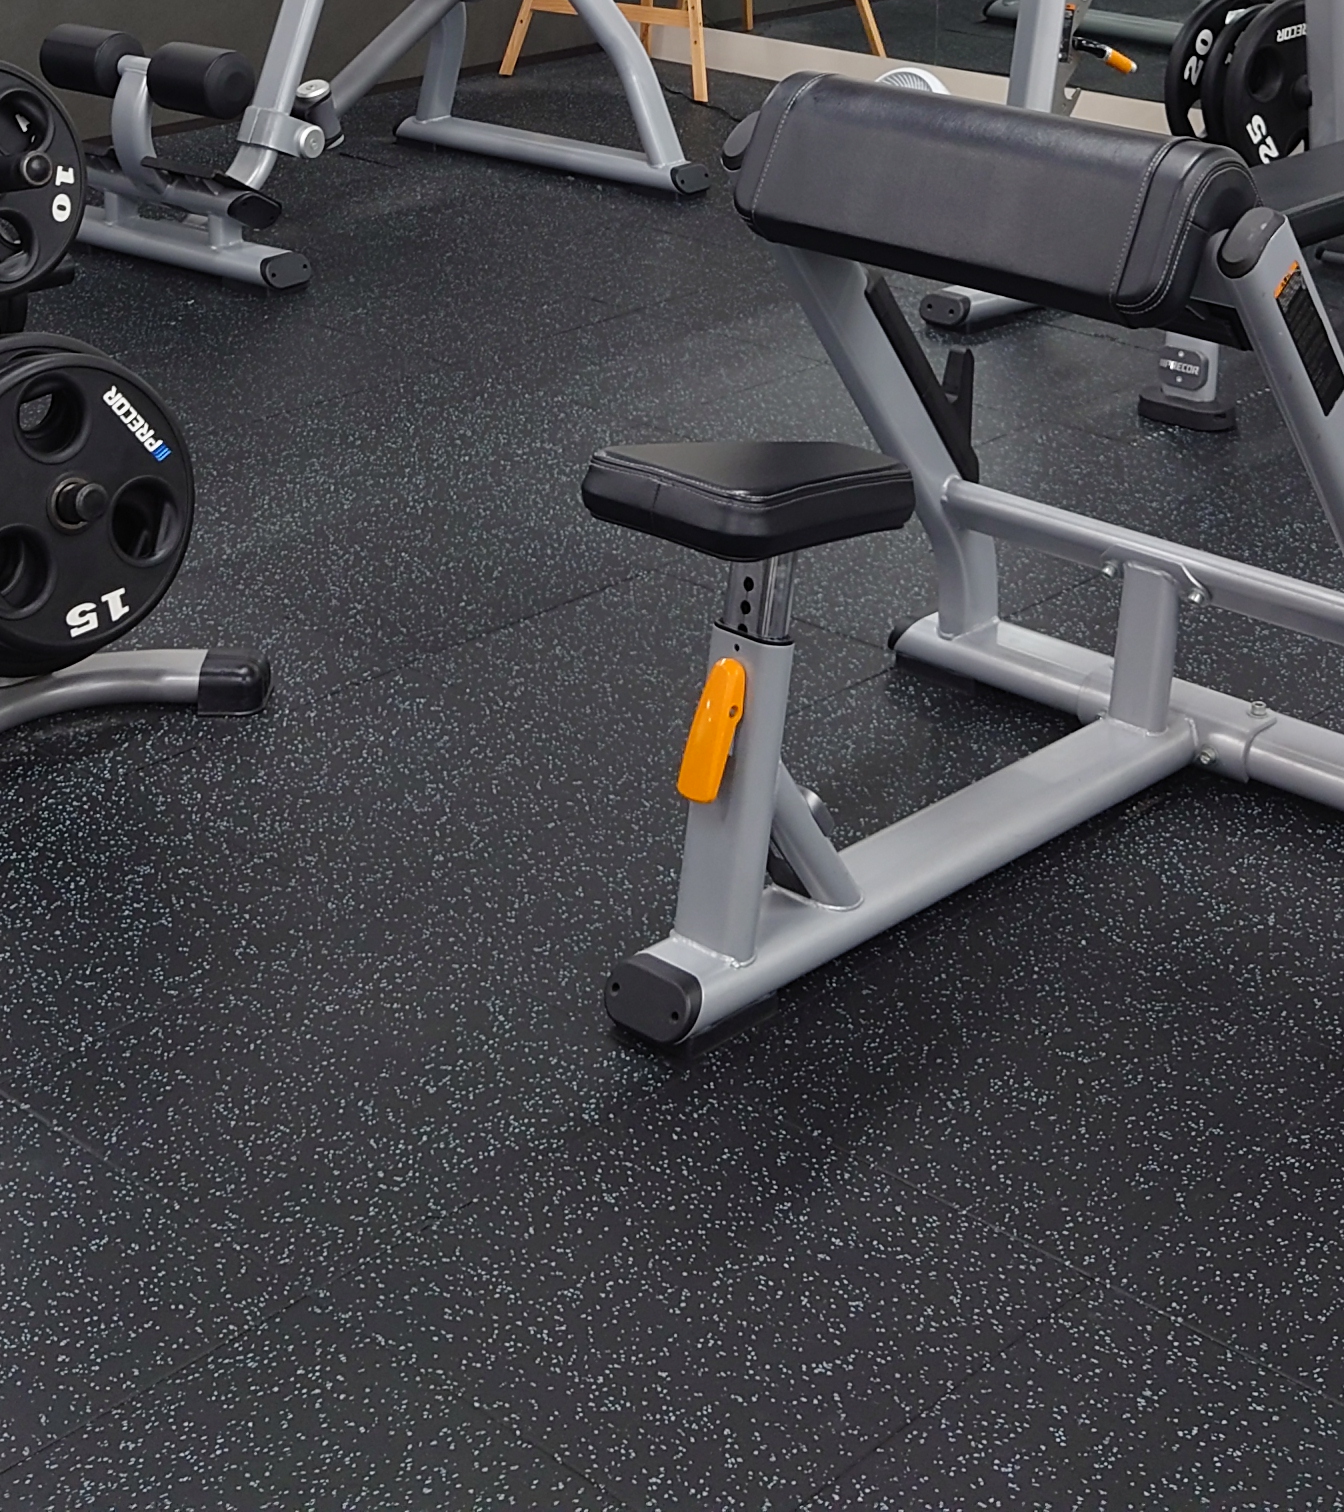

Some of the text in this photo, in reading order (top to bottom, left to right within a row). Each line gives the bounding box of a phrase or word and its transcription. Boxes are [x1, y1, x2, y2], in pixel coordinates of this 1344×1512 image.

[1183, 29, 1214, 85] 20
[1245, 114, 1280, 165] 25
[52, 166, 75, 222] 10
[1167, 359, 1200, 376] PRECOR
[103, 385, 161, 453] PRECOR
[65, 587, 132, 638] 15
